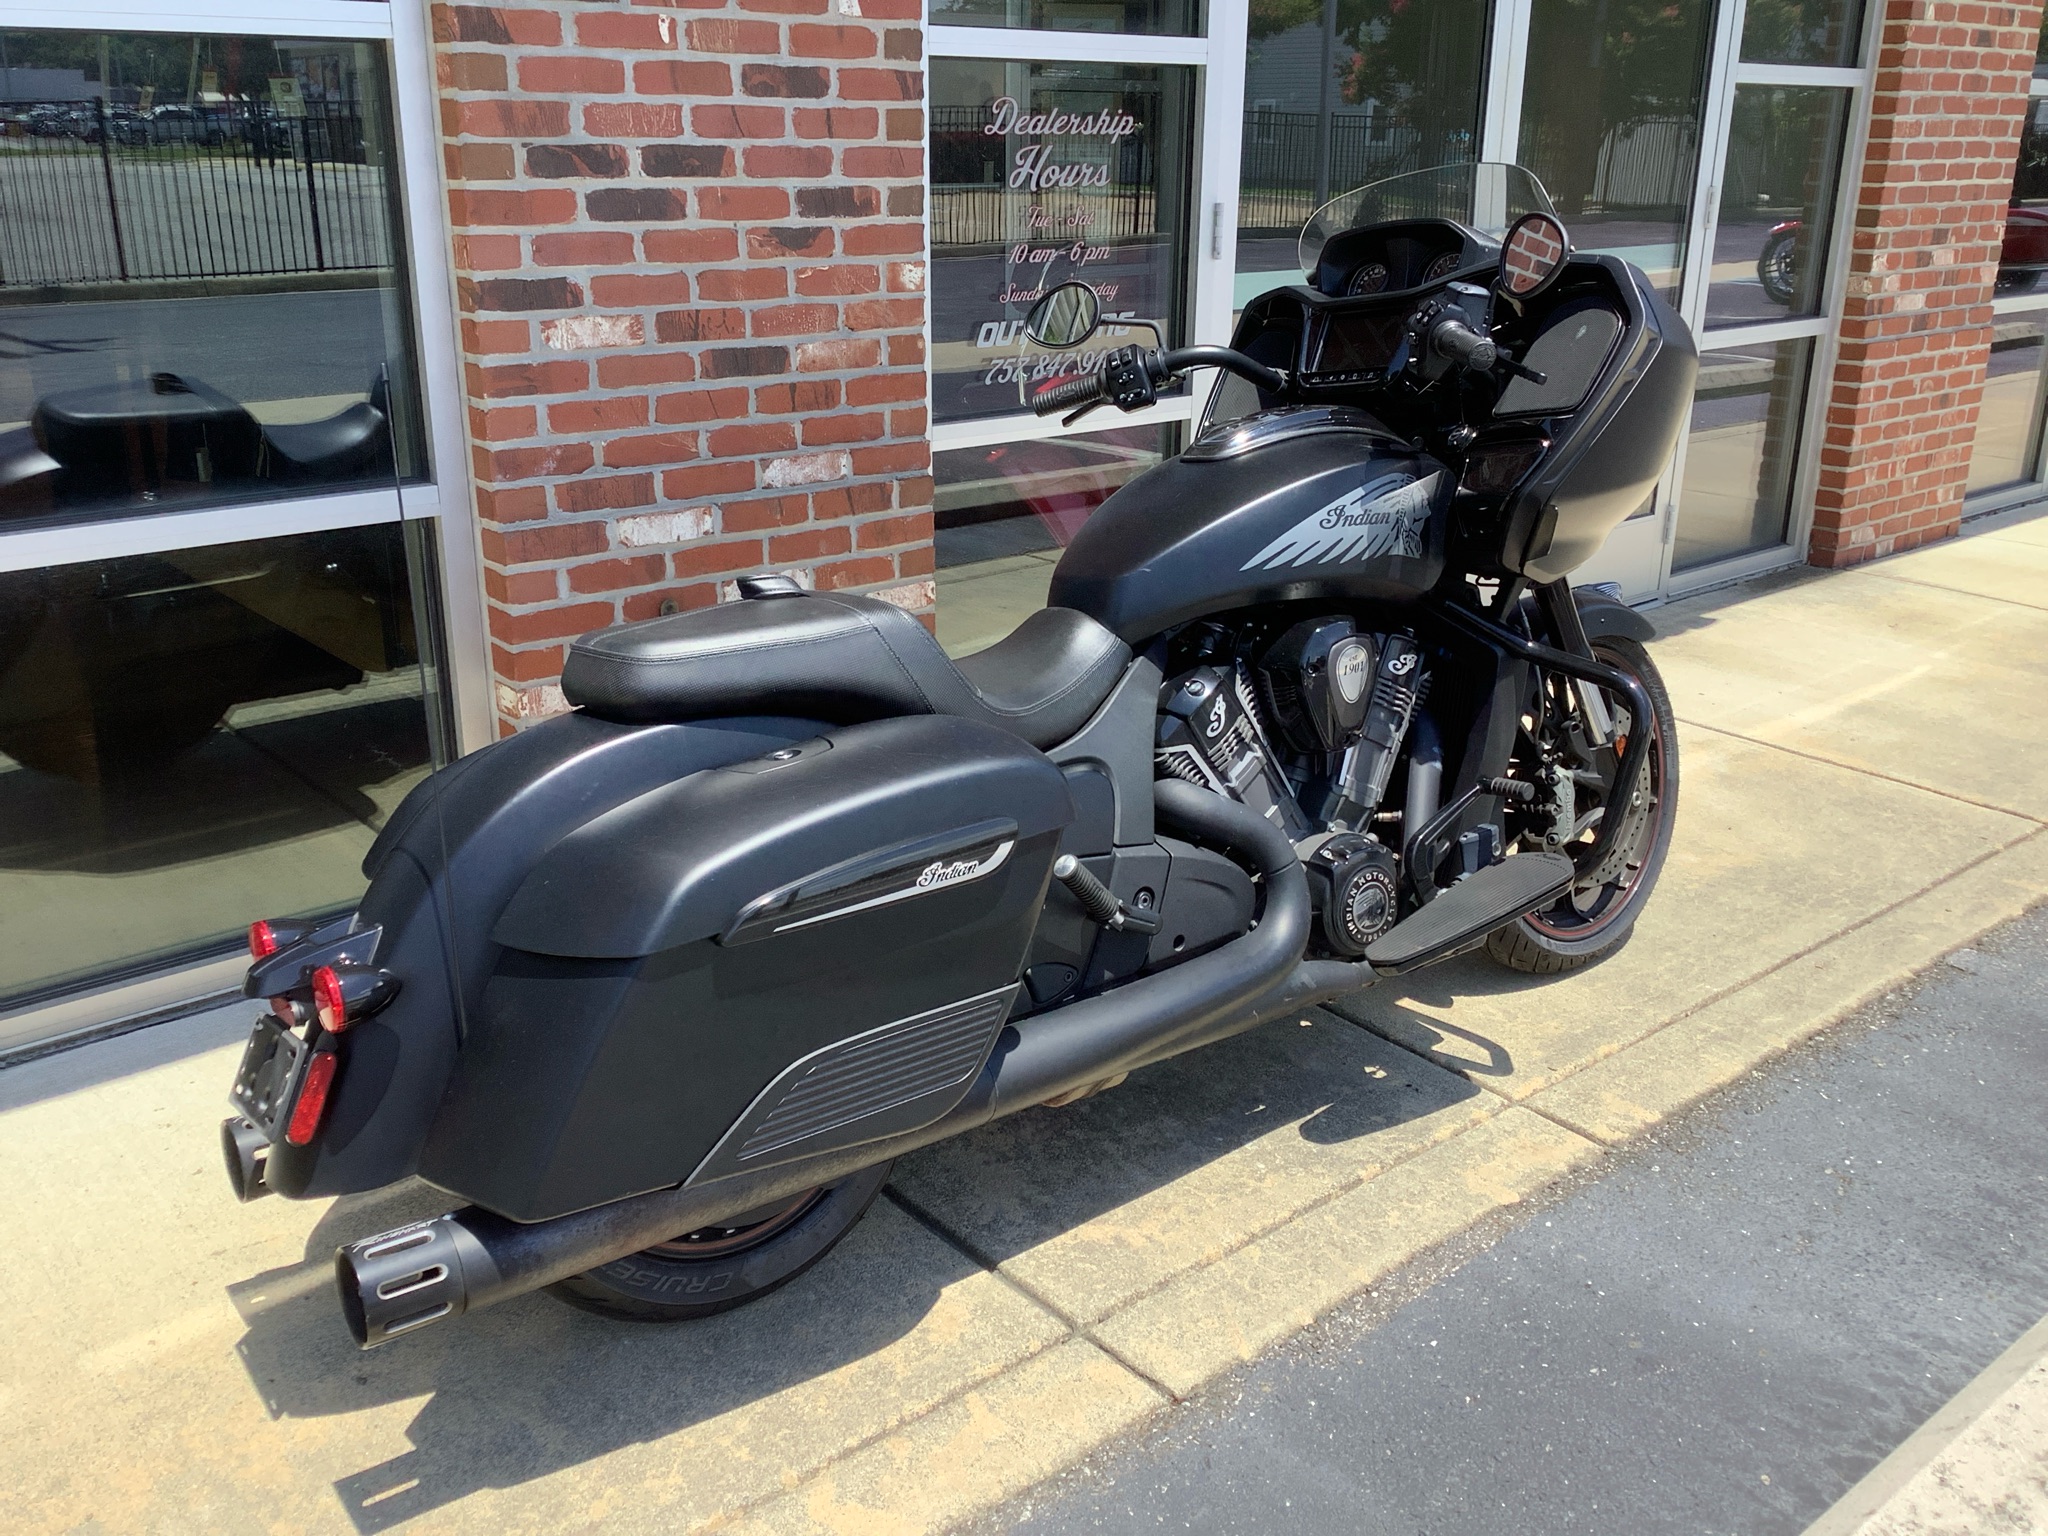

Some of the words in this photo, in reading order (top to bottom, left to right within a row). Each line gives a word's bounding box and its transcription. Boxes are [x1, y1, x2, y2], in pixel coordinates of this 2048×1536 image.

[984, 96, 1135, 144] Dealership
[1009, 144, 1111, 191] Hours
[1027, 205, 1053, 229] Tue
[1067, 204, 1095, 227] Sat
[1008, 244, 1029, 264] 10
[1029, 247, 1056, 263] am
[1070, 241, 1085, 262] 6
[1080, 246, 1111, 267] pm
[999, 282, 1049, 304] Sunda
[1319, 504, 1391, 529] Indian
[1344, 661, 1364, 676] 1901
[917, 861, 979, 888] Indian
[1345, 886, 1359, 935] INDIAN
[1358, 871, 1397, 922] MOTORCYCLE
